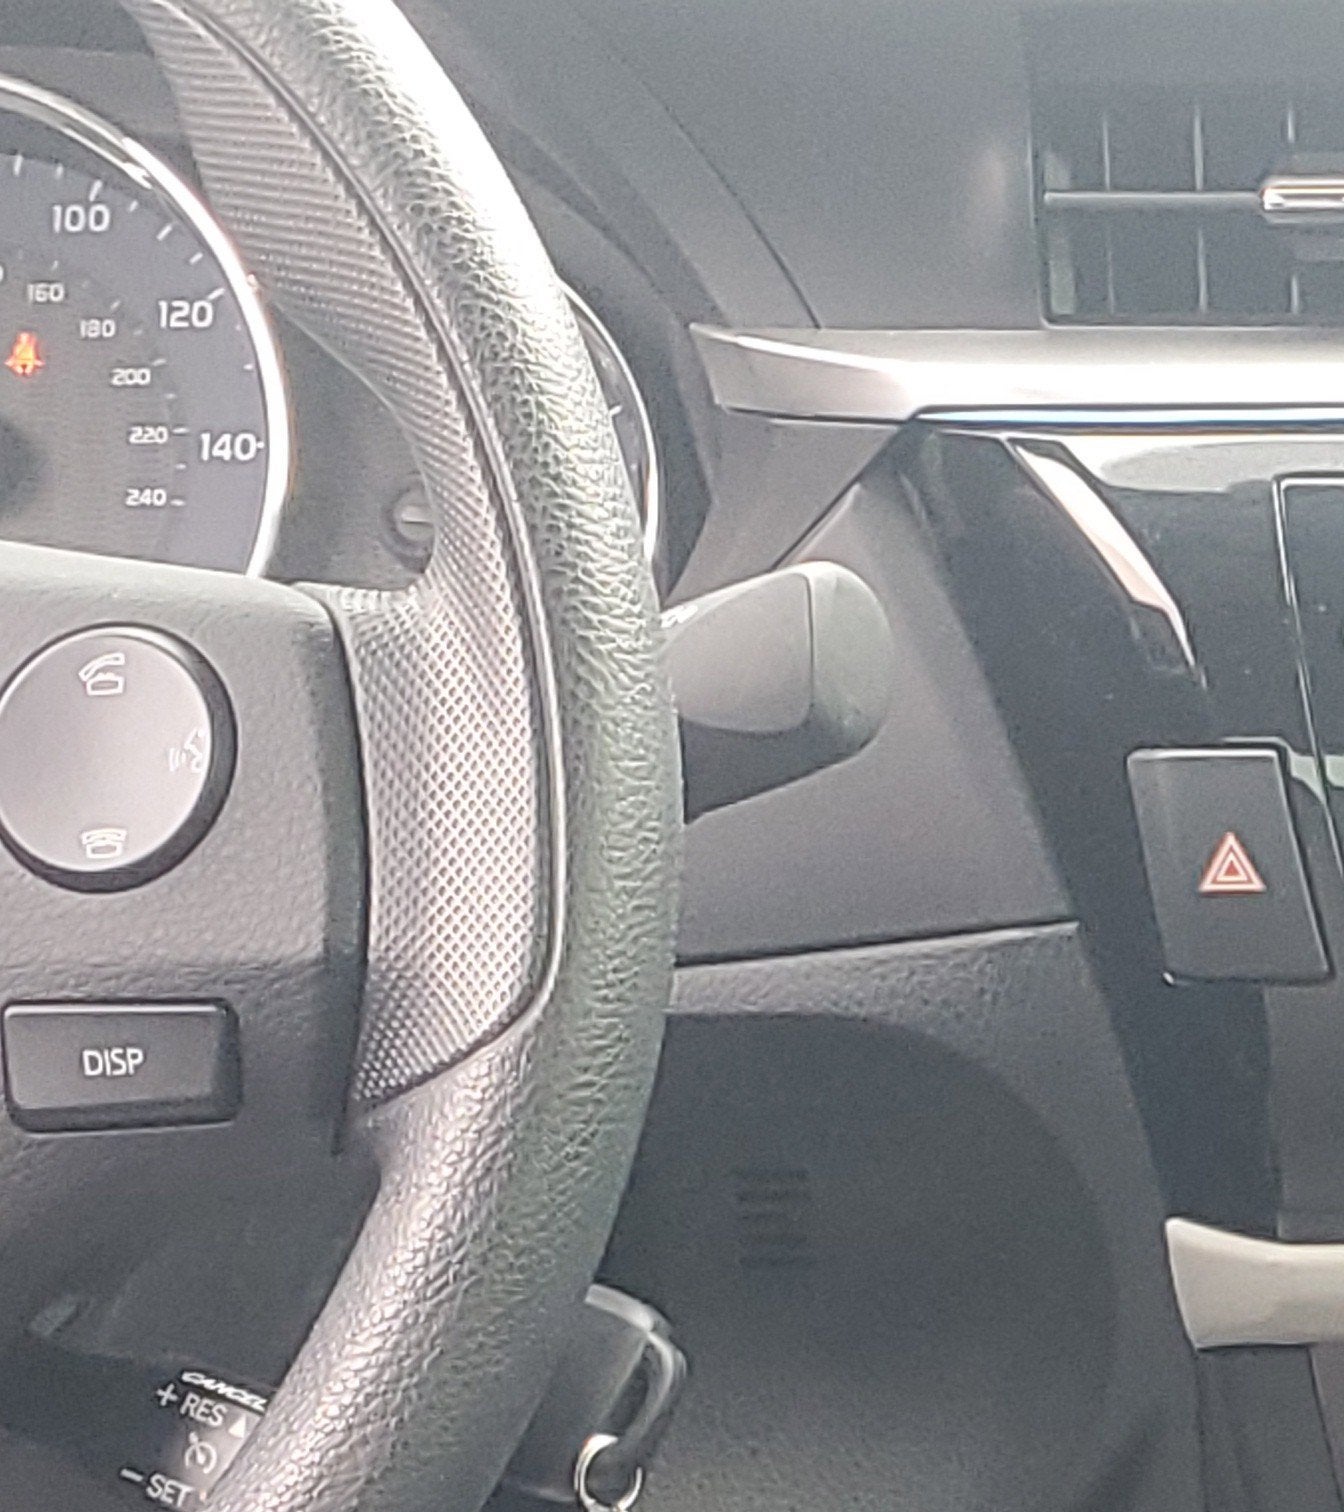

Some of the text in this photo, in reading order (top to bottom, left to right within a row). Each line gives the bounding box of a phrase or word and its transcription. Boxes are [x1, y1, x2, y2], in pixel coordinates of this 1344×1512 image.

[53, 204, 111, 233] 100
[27, 283, 65, 302] 160
[158, 300, 213, 329] 120
[80, 319, 116, 338] 180
[111, 368, 151, 386] 200
[129, 426, 169, 444] 220
[200, 432, 257, 461] 140
[125, 488, 167, 506] 240
[82, 1047, 144, 1076] DISP
[181, 1371, 268, 1411] CANCEL
